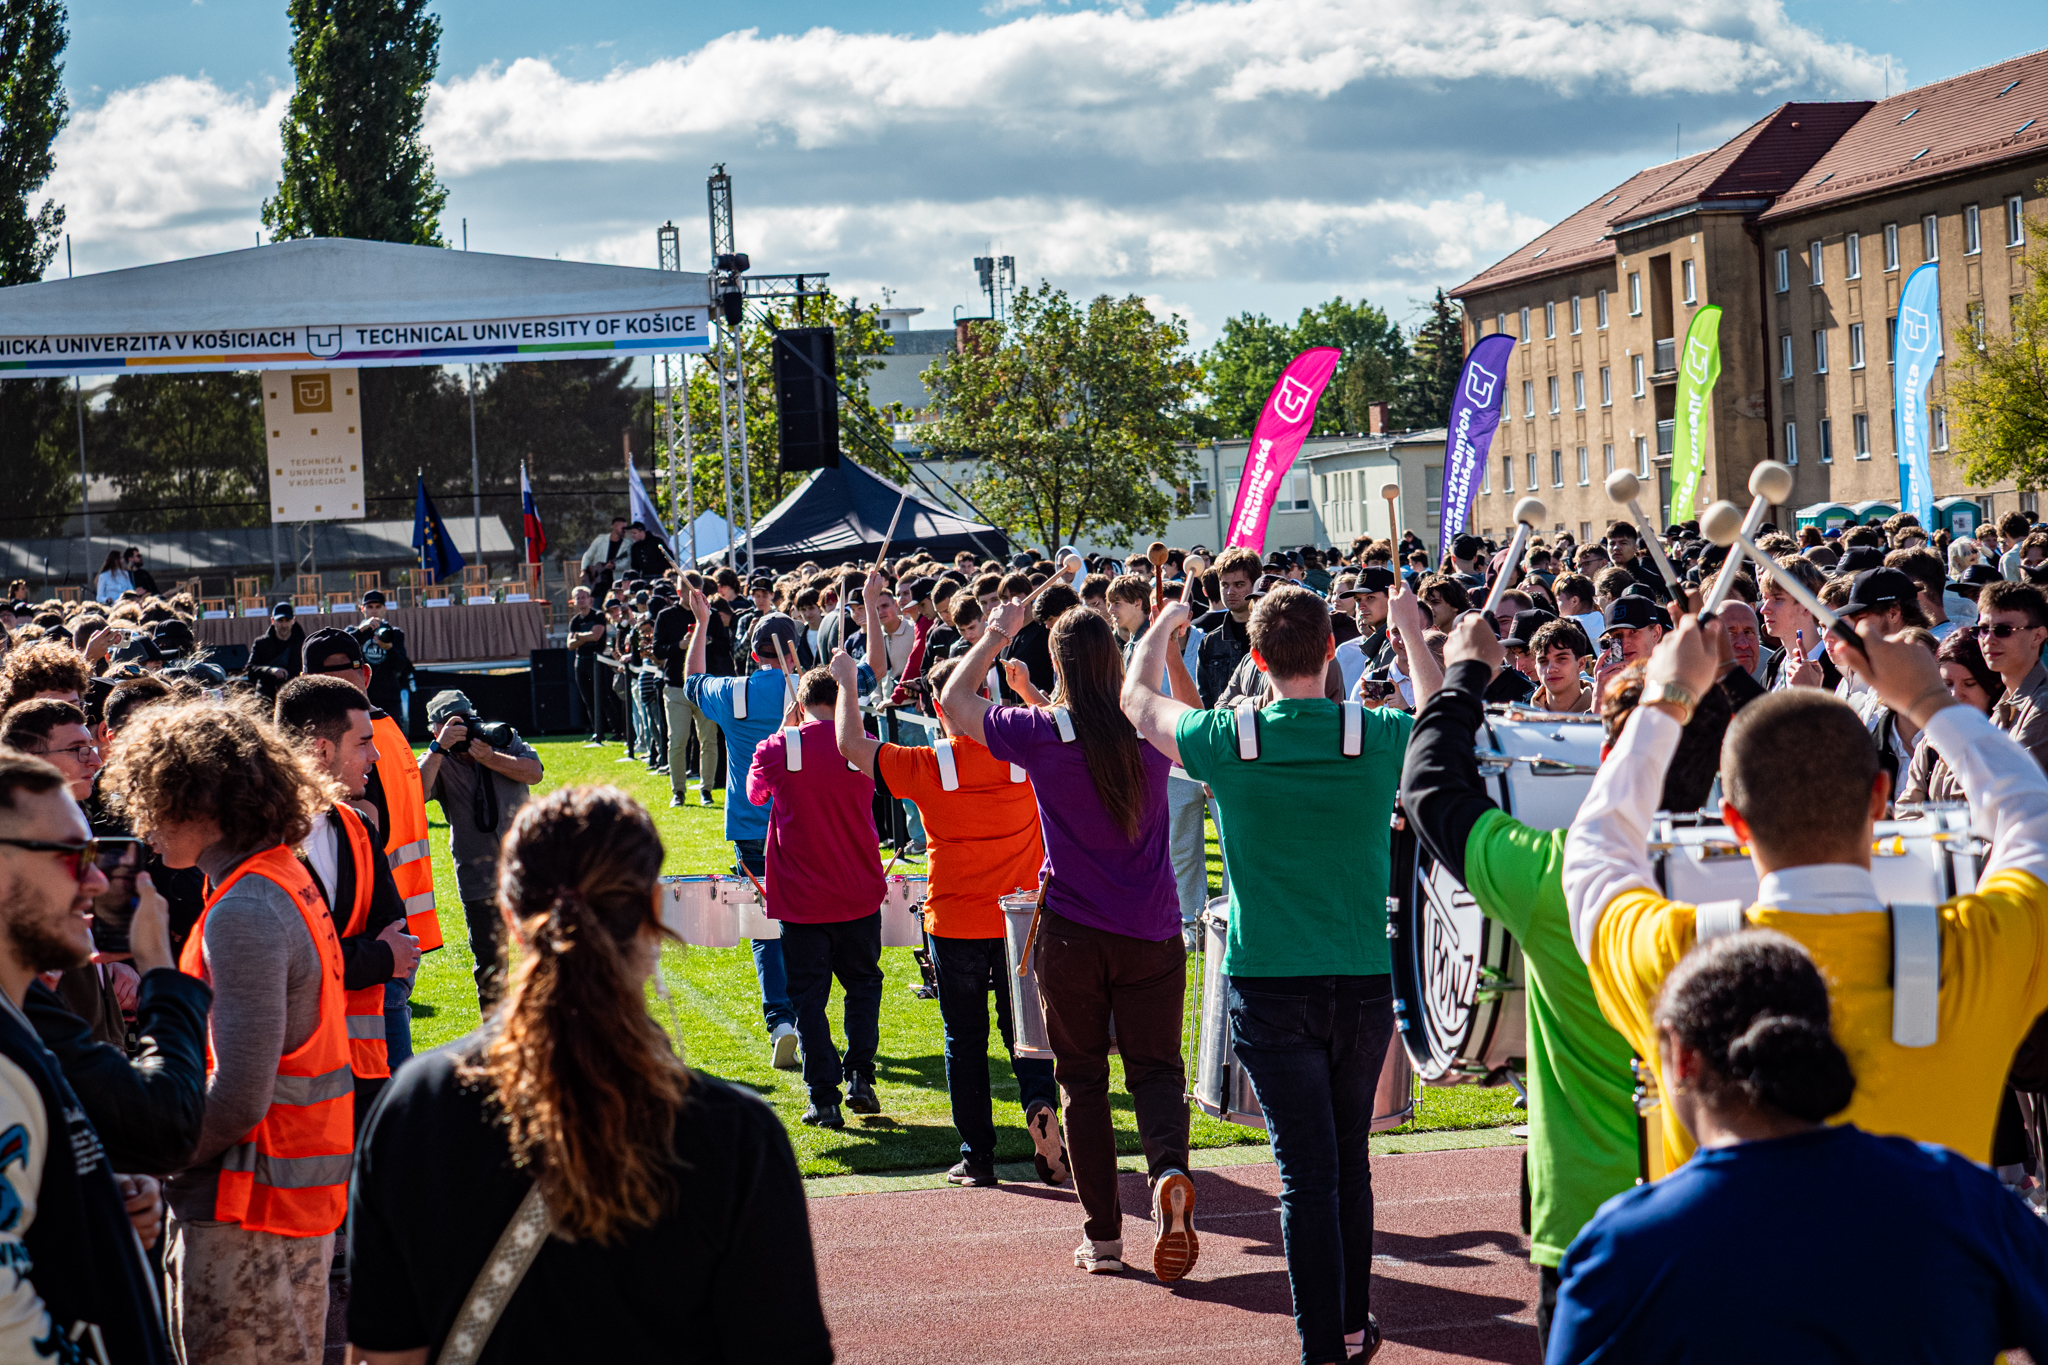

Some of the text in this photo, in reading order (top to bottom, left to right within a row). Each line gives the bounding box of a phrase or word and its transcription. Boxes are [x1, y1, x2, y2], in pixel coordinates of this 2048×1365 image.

[56, 334, 171, 354] UNIVERZITA
[175, 334, 188, 350] V
[192, 330, 296, 349] KOŠICIACH
[356, 313, 697, 345] TECHNICAL UNIVERSITY OF KOŠICE
[290, 456, 343, 466] TECHNICKÁ
[1448, 406, 1472, 503] výrobných
[289, 467, 344, 477] UNIVERZITA
[296, 477, 346, 487] KOŠICIACH
[1241, 469, 1274, 536] fakulta
[1429, 918, 1474, 1024] BONZ
